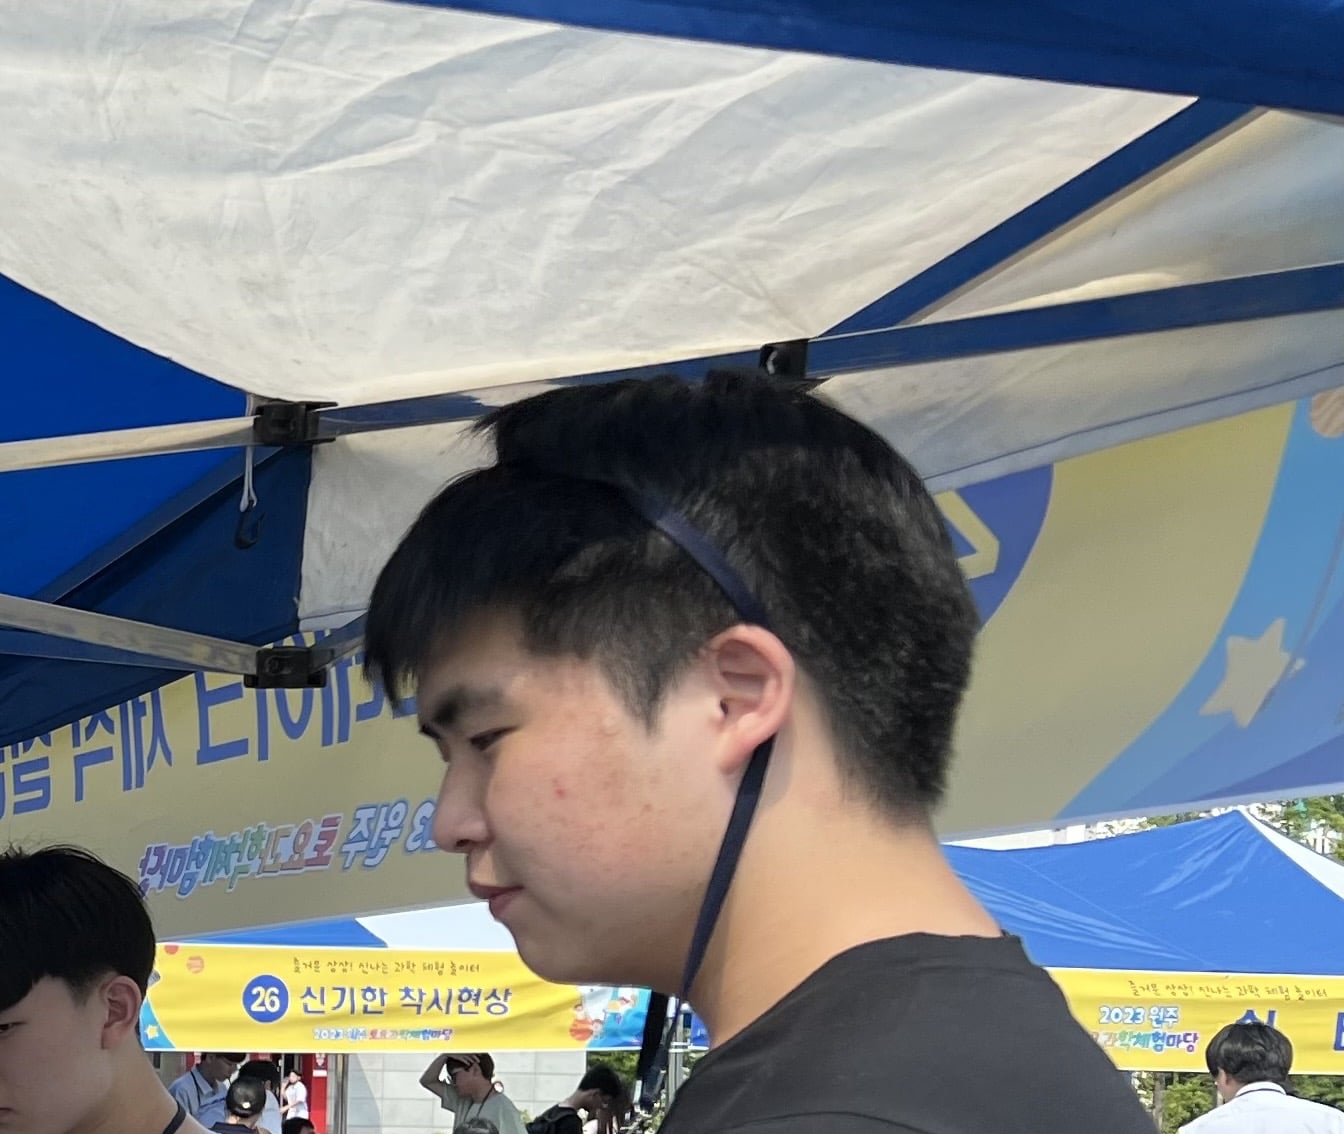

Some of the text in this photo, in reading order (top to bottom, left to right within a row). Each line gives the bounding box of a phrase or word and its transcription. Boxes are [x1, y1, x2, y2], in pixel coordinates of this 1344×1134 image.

[250, 986, 513, 1015] 26 신기한 착시현상
[1098, 1005, 1179, 1028] 2023 원주
